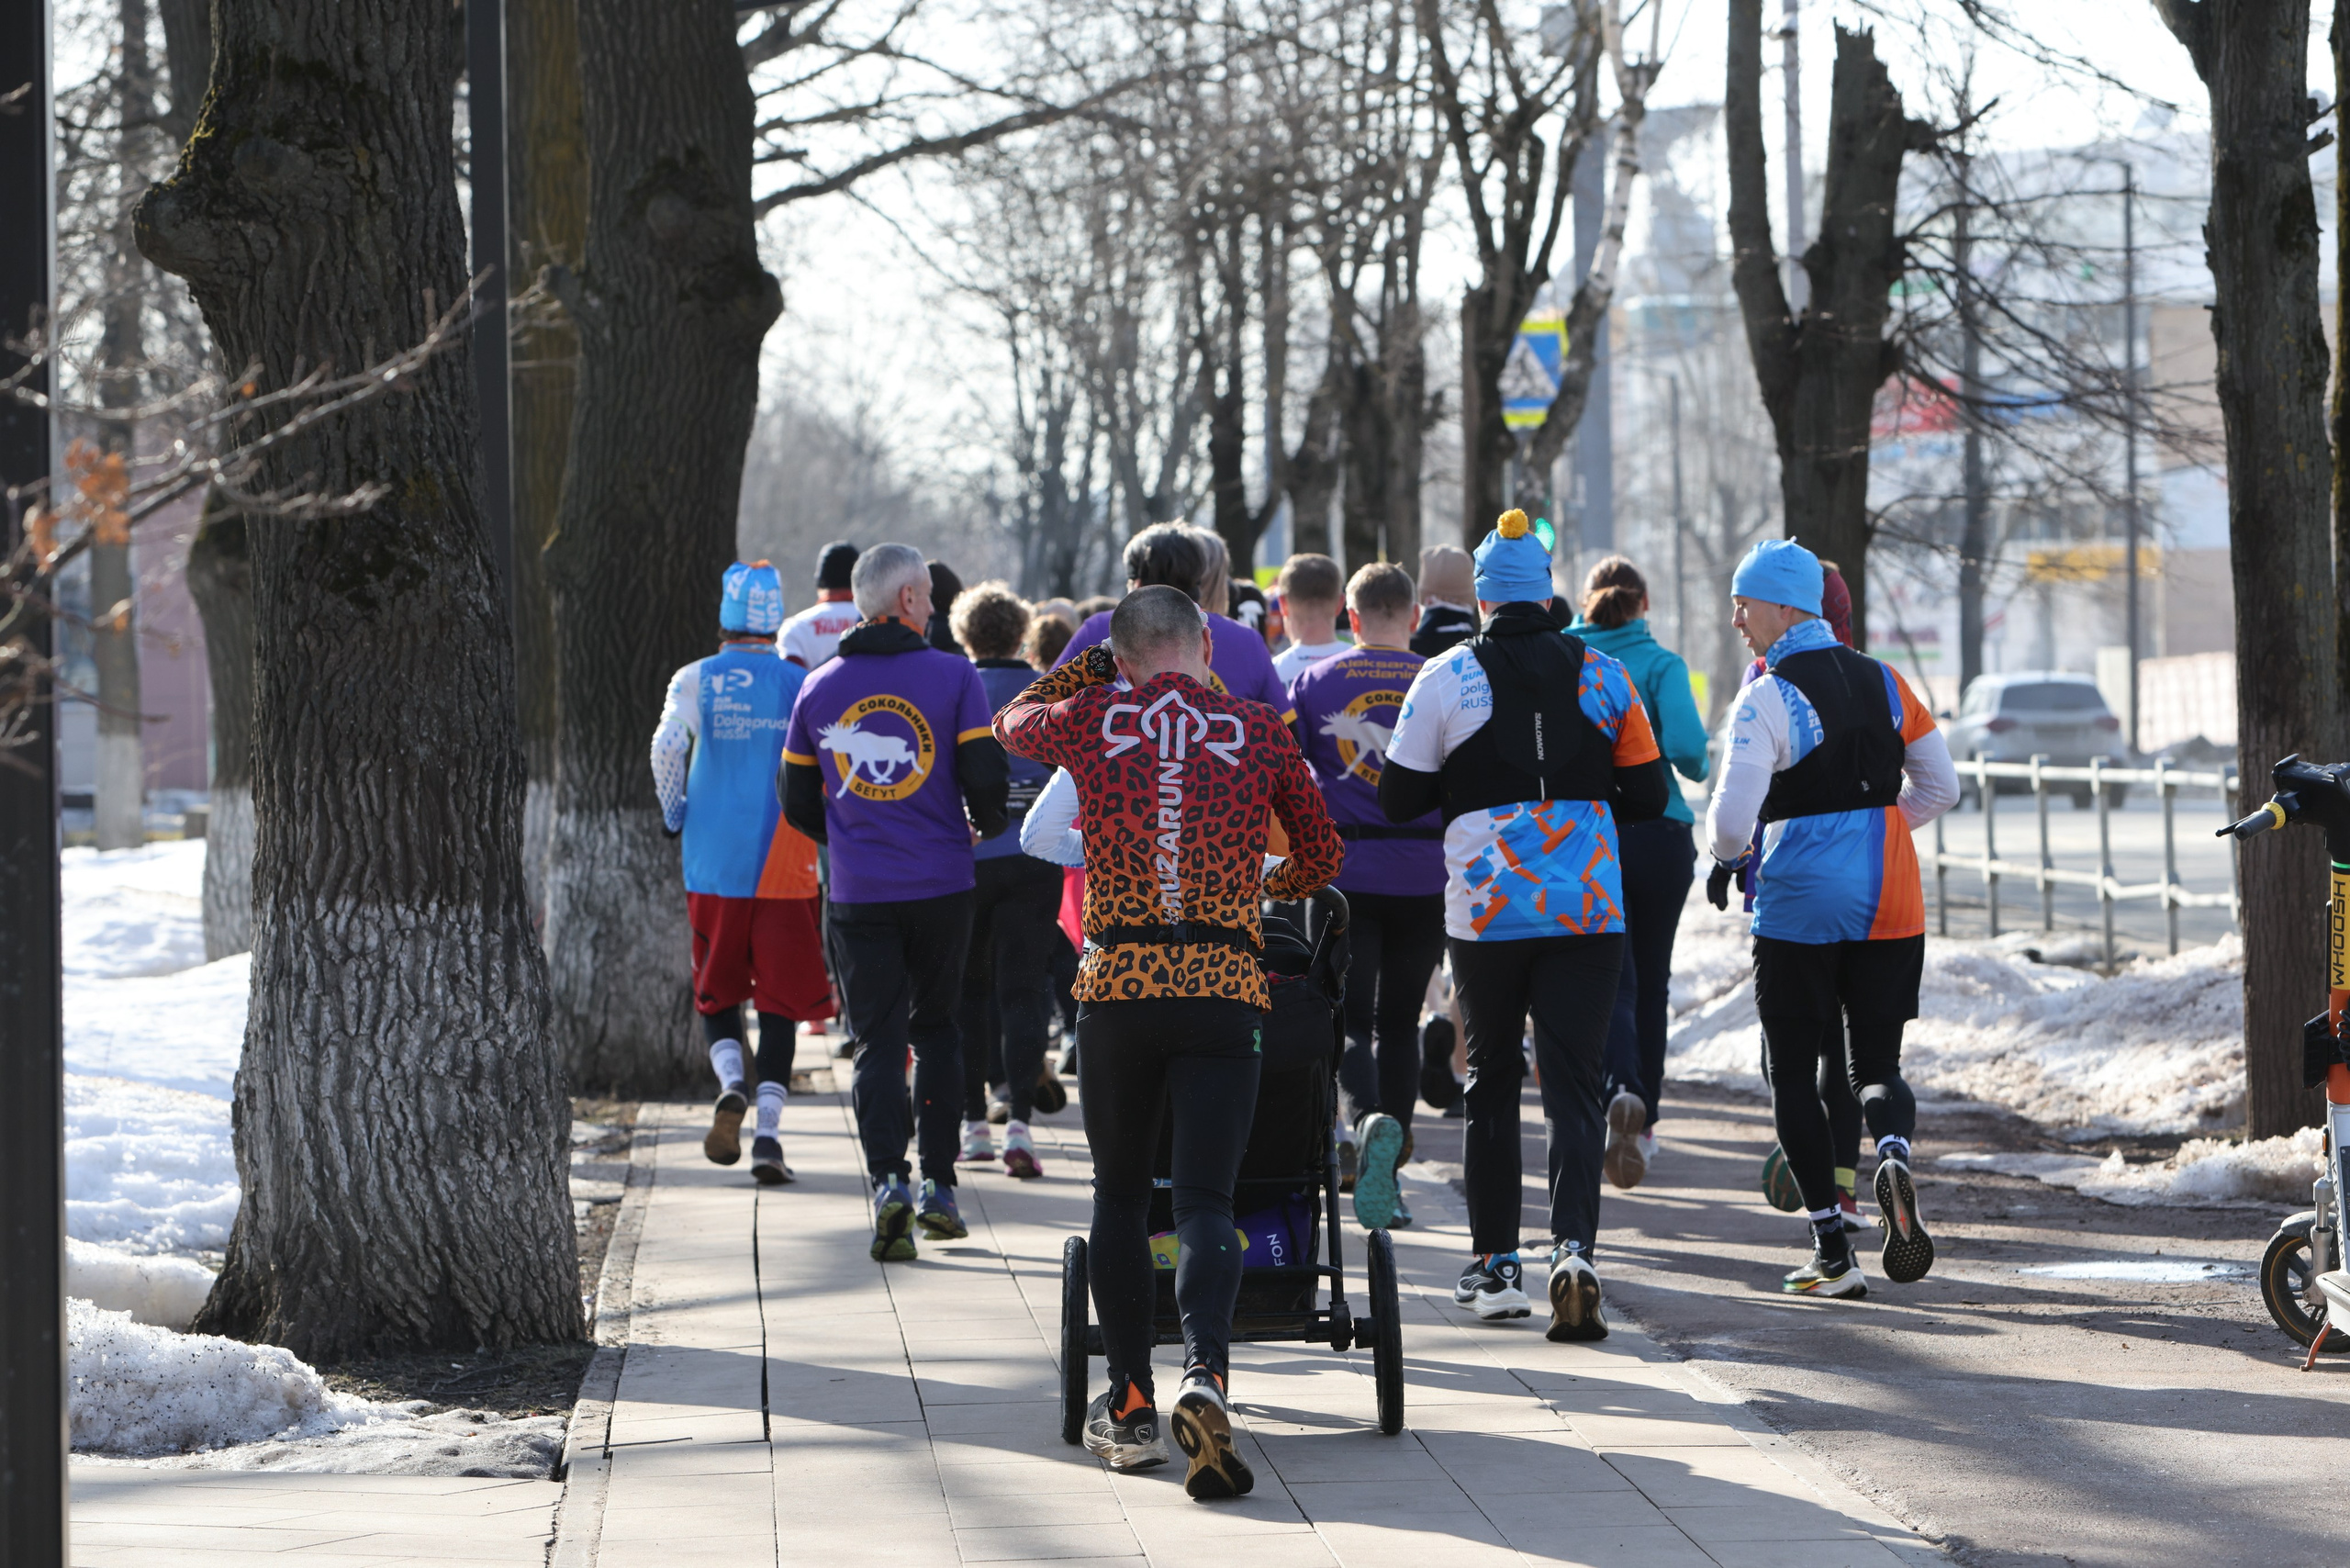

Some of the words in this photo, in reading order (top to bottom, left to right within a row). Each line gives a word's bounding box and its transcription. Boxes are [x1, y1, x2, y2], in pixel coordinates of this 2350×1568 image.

[1461, 669, 1484, 683] RUN
[713, 714, 790, 732] Dolgoprud
[858, 699, 932, 753] СОКОЛЬНИКИ
[1535, 711, 1544, 761] SALOMON
[855, 782, 897, 798] БЕГУТ
[2333, 879, 2346, 986] WHOOSH
[1267, 1234, 1285, 1267] FON
